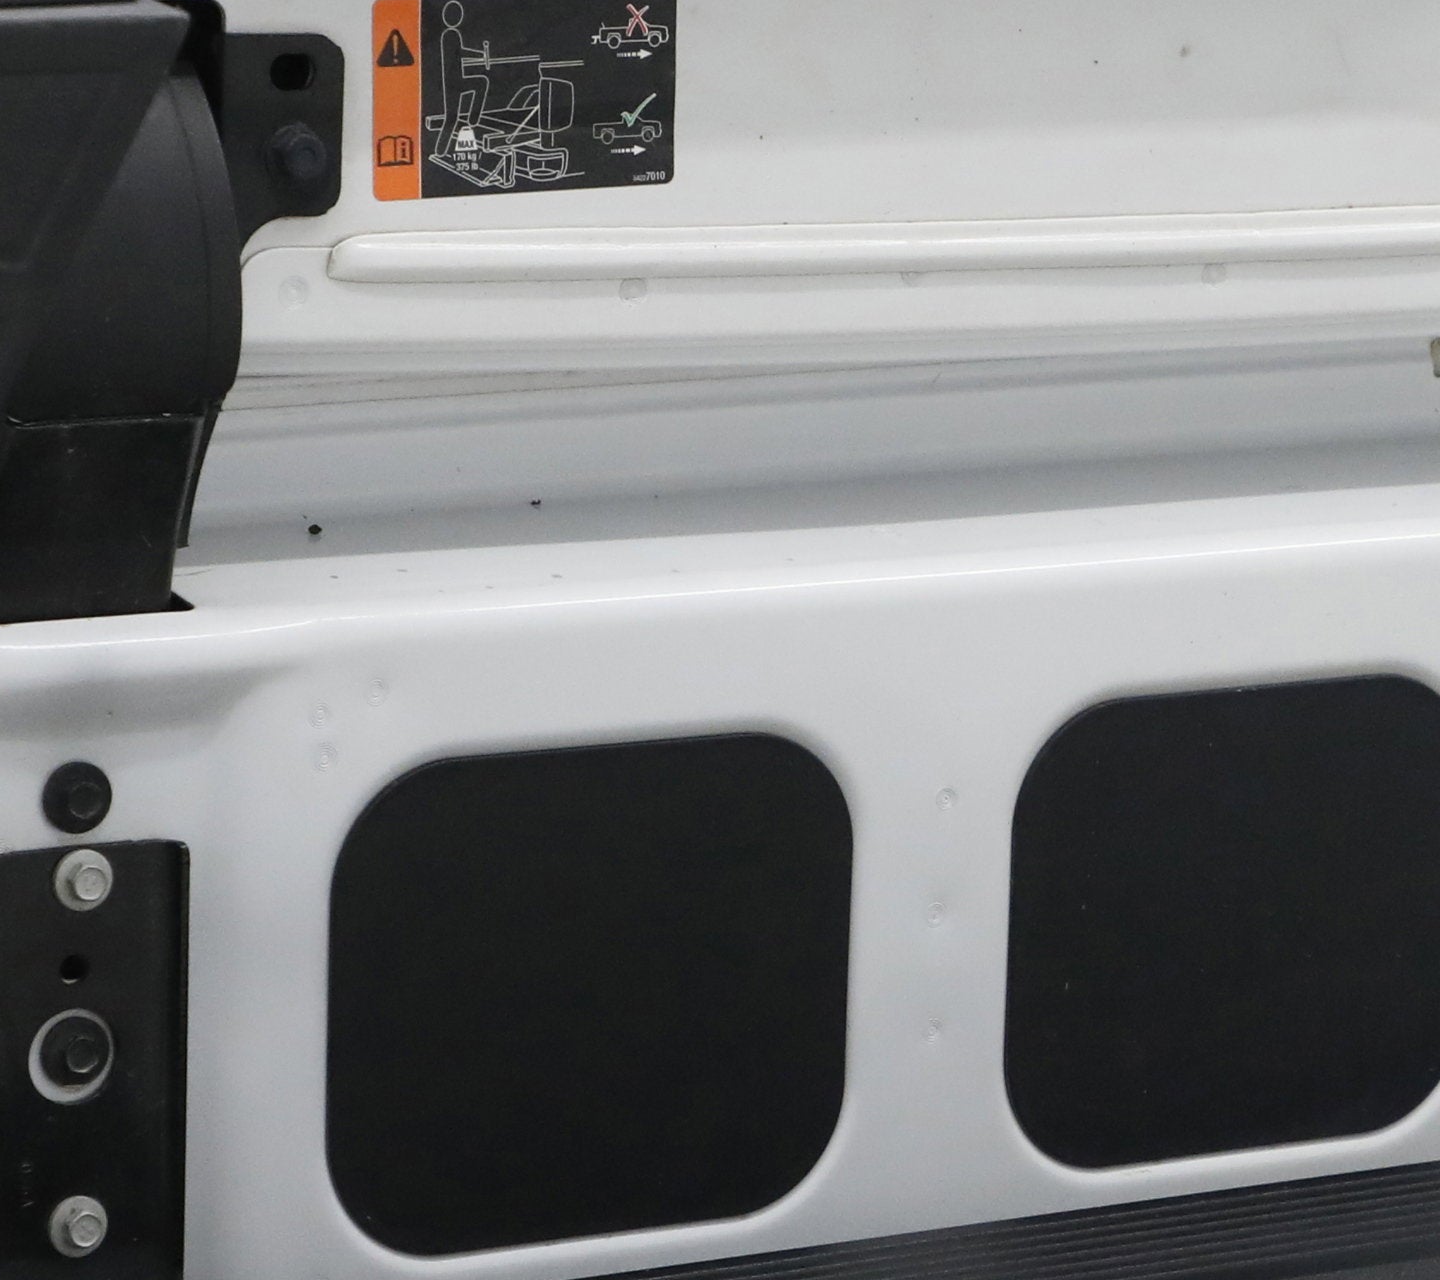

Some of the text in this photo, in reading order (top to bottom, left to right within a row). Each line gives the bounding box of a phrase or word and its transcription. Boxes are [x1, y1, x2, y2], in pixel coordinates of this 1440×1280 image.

[458, 140, 474, 148] MAX
[453, 152, 466, 161] 170
[467, 151, 477, 162] kg
